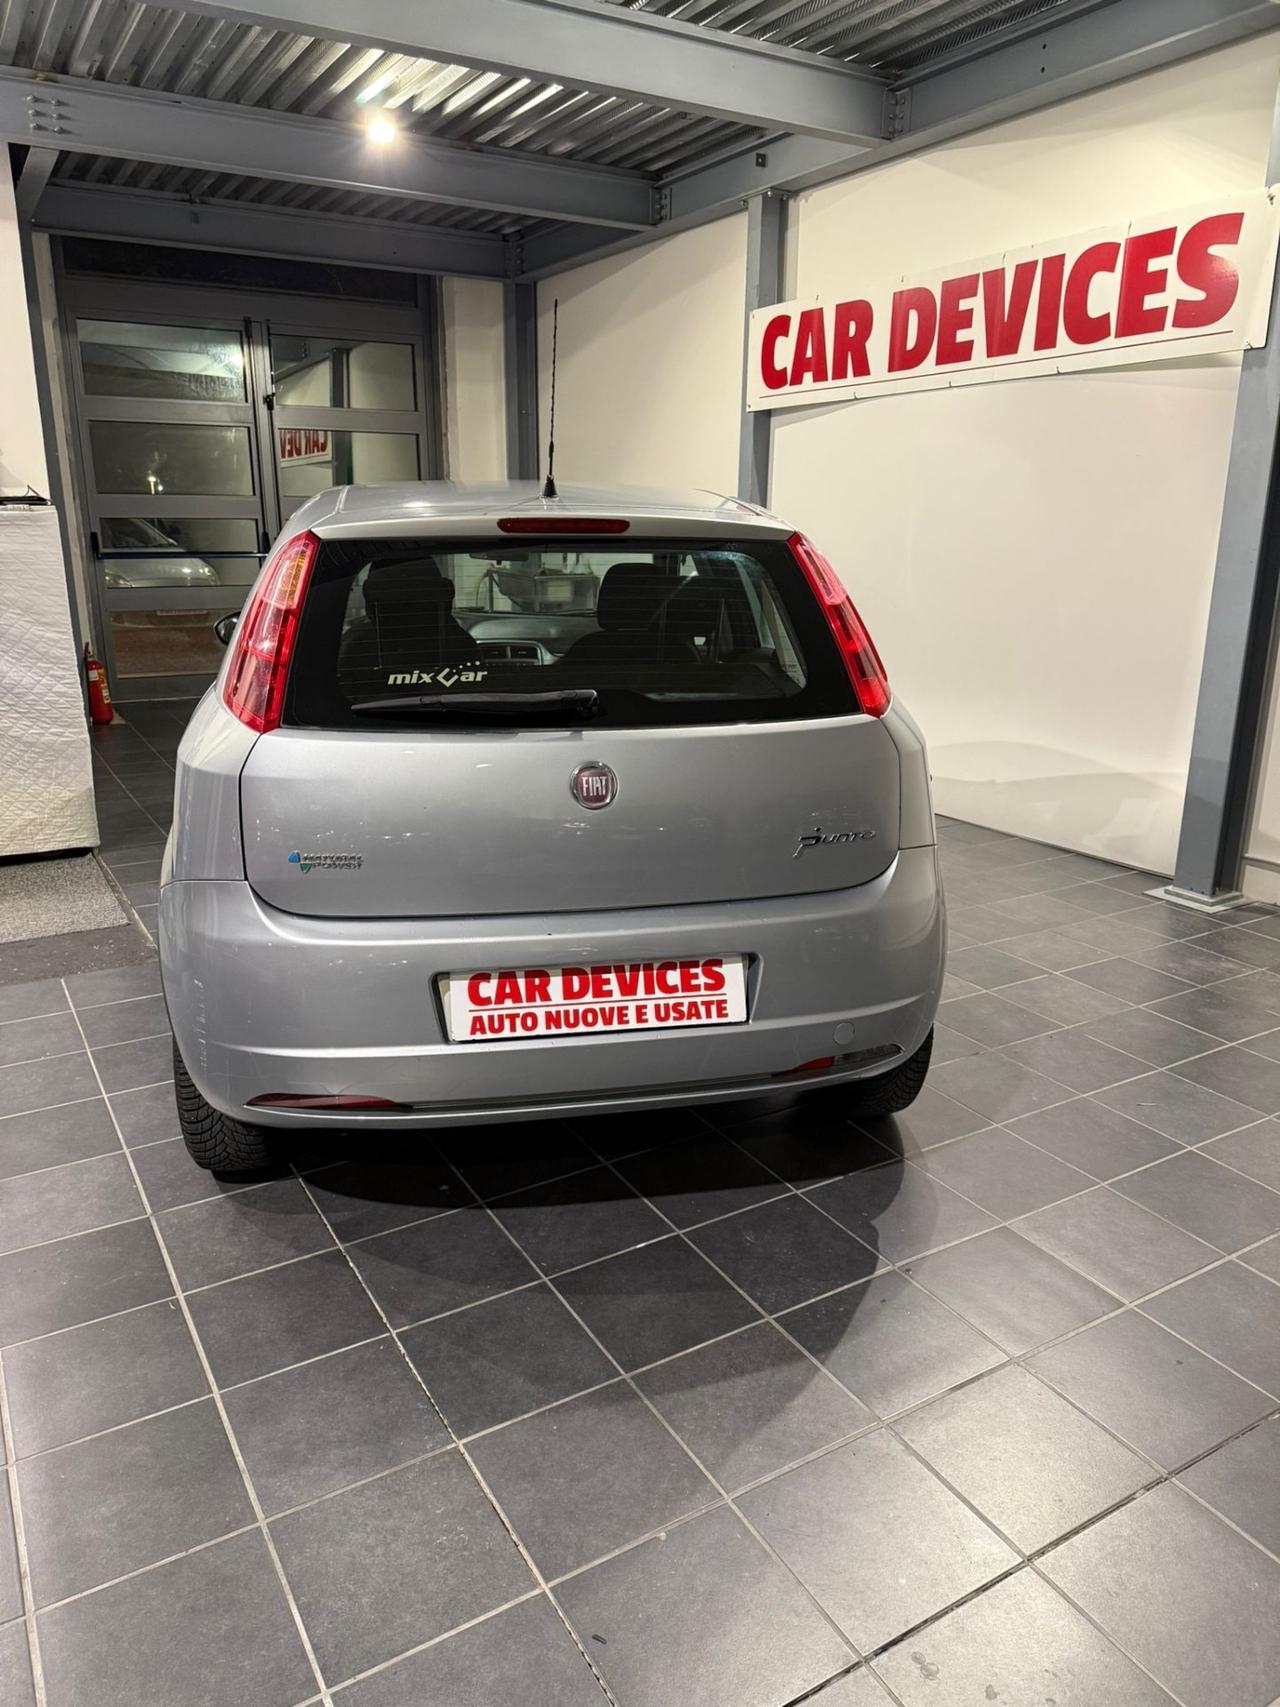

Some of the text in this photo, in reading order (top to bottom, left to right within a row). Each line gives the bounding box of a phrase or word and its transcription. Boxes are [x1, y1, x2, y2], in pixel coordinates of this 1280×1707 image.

[761, 212, 1245, 390] CAR DEVICES
[581, 776, 608, 796] FIAT
[468, 959, 726, 1006] CAR DEVICES
[469, 999, 729, 1035] AUTO NUOVE E USATE
